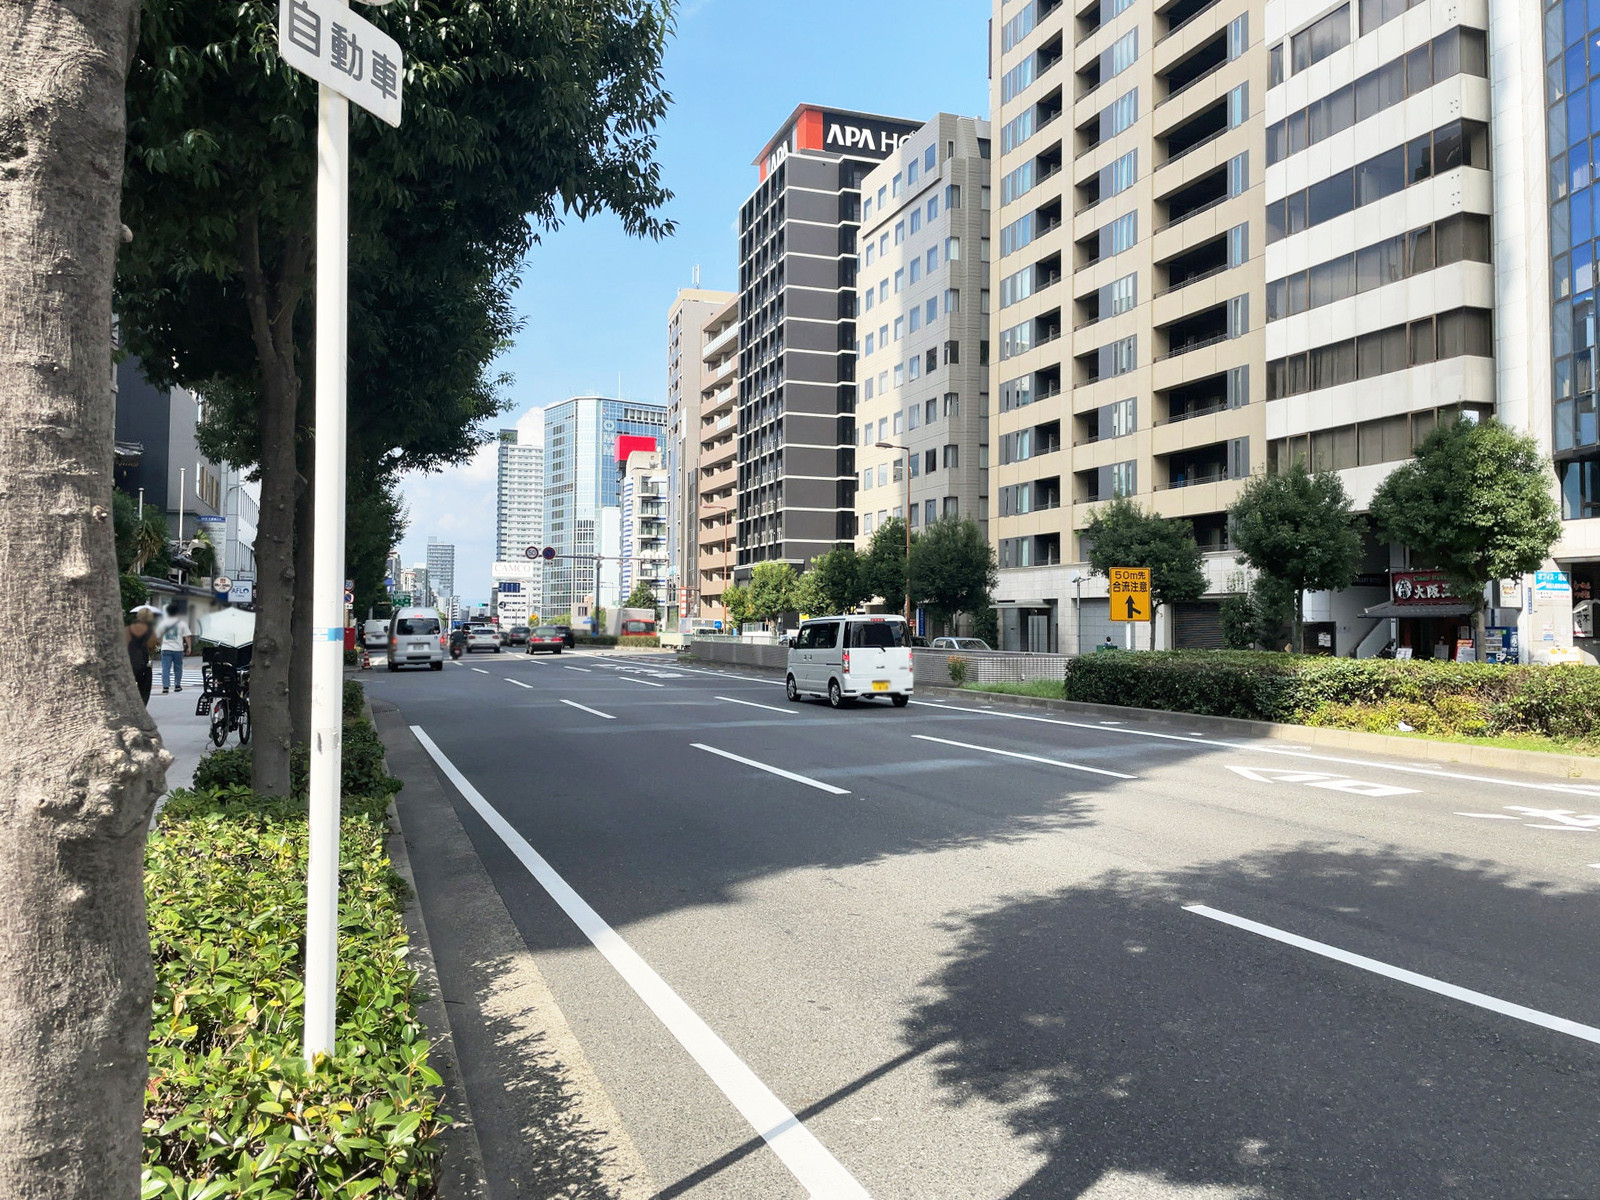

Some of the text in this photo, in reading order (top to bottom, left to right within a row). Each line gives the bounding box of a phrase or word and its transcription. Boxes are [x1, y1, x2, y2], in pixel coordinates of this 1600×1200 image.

[289, 0, 398, 100] 自動車
[826, 123, 876, 151] APA
[494, 564, 531, 572] CAMCO
[1115, 570, 1146, 580] 50m先
[1113, 581, 1147, 593] 合流注意
[1414, 584, 1460, 599] 大阪王
